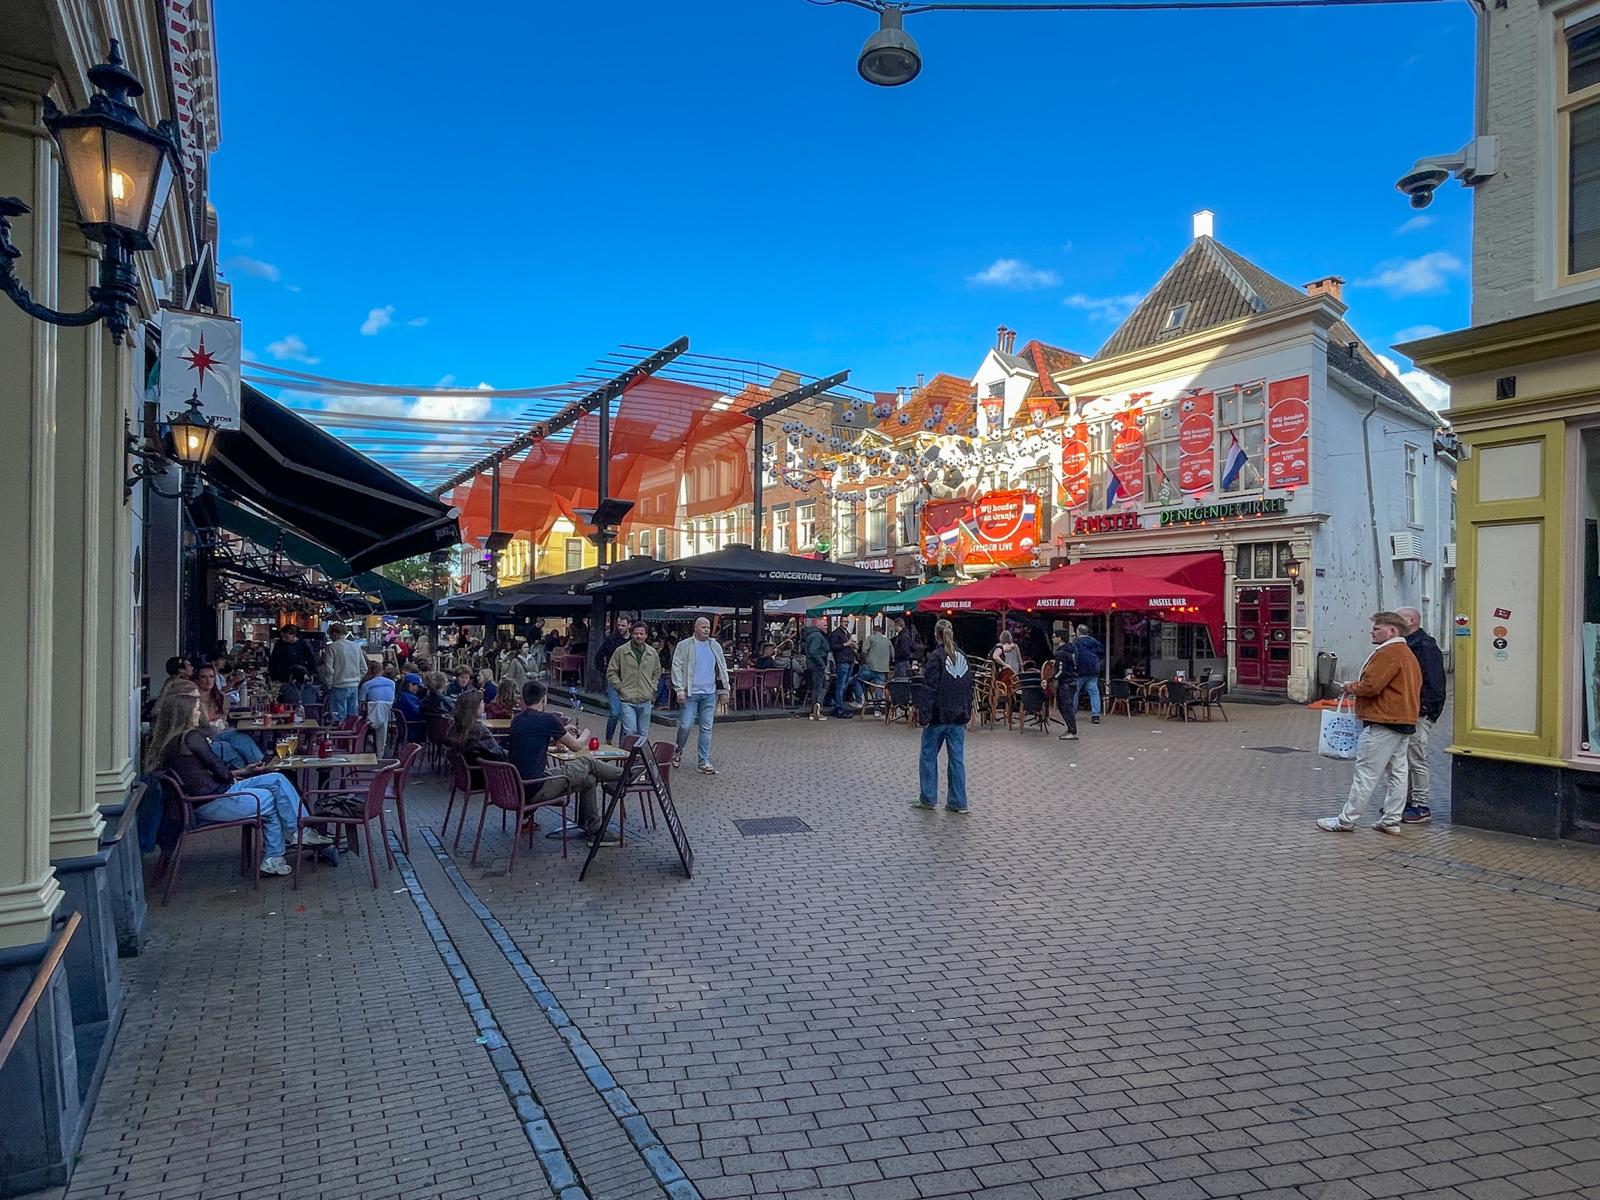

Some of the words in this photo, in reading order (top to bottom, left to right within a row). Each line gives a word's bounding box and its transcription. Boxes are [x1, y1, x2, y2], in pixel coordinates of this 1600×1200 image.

[980, 504, 992, 513] Wij
[992, 503, 1018, 512] houden
[1160, 509, 1175, 524] DE
[1176, 503, 1236, 520] NEGENDE
[1075, 512, 1142, 532] AMSTEL
[998, 542, 1014, 551] LIVE
[769, 571, 822, 581] CONCERTHUIS
[1036, 599, 1059, 607] AMSTEL
[1059, 598, 1076, 606] BIER
[1149, 598, 1172, 606] AMSTEL
[1172, 598, 1187, 606] BIER
